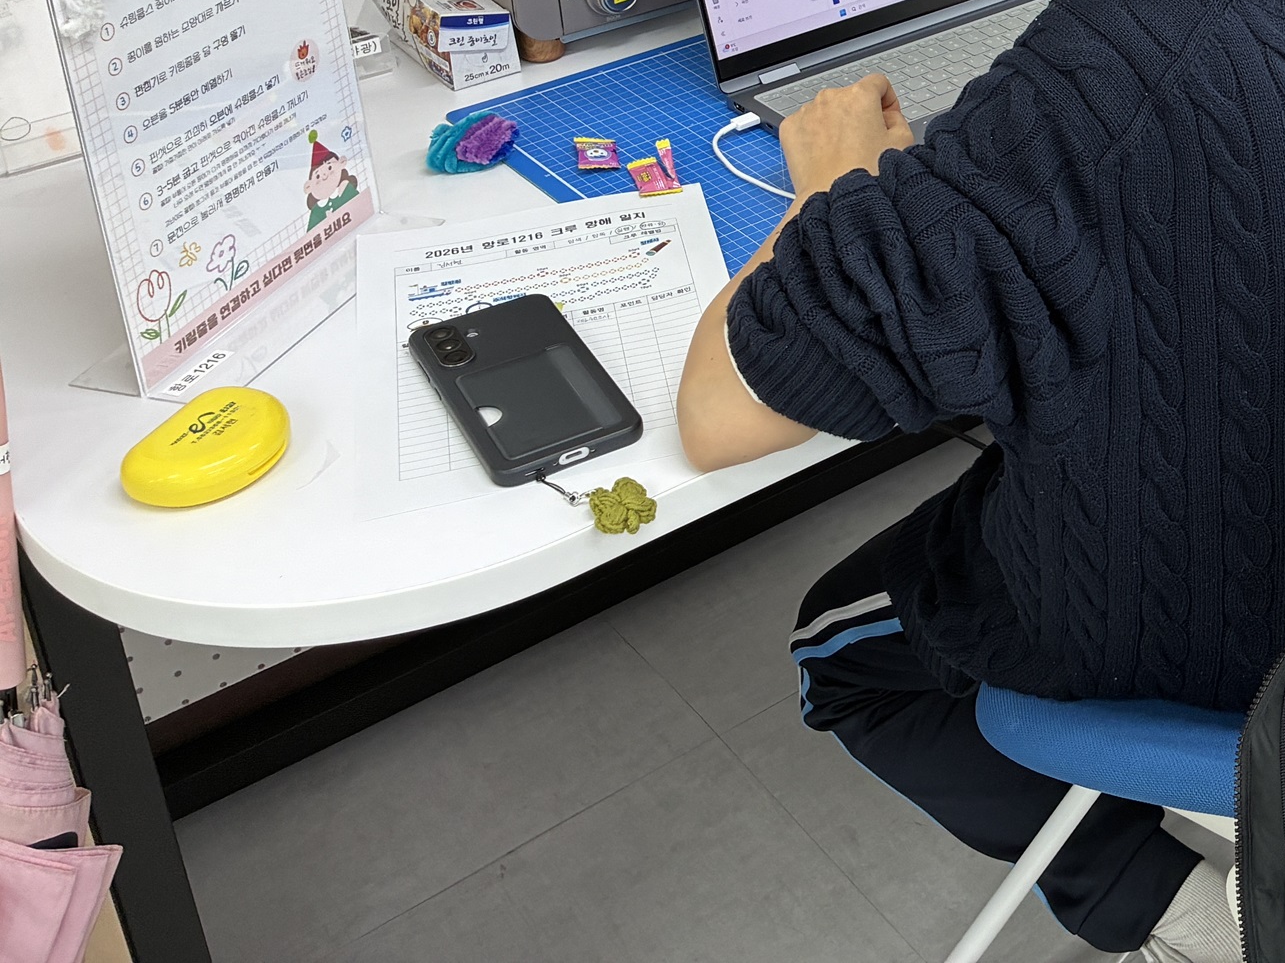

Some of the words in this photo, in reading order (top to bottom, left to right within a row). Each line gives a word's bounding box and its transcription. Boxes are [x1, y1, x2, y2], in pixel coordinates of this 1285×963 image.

[154, 29, 179, 48] 원하는
[213, 35, 229, 50] 구멍
[464, 71, 485, 82] 25cm
[489, 62, 510, 75] 20m
[142, 108, 167, 131] 오븐을
[201, 69, 232, 94] 예열하기
[209, 104, 233, 126] 오븐에
[156, 174, 181, 197] 3-5분
[224, 176, 255, 203] 평평하게
[256, 160, 279, 182] 만들기
[425, 244, 474, 259] 2026년
[482, 231, 544, 250] 항로1216
[550, 224, 578, 237] 크루
[585, 217, 612, 230] 항해
[619, 211, 646, 223] 일지
[219, 278, 261, 321] 연결하고
[262, 257, 293, 290] 싶다면
[293, 233, 323, 265] 뒷면을
[323, 211, 353, 240] 보세요
[620, 299, 642, 308] 포인트
[651, 292, 673, 302] 담당자
[169, 352, 226, 392] 항로1216
